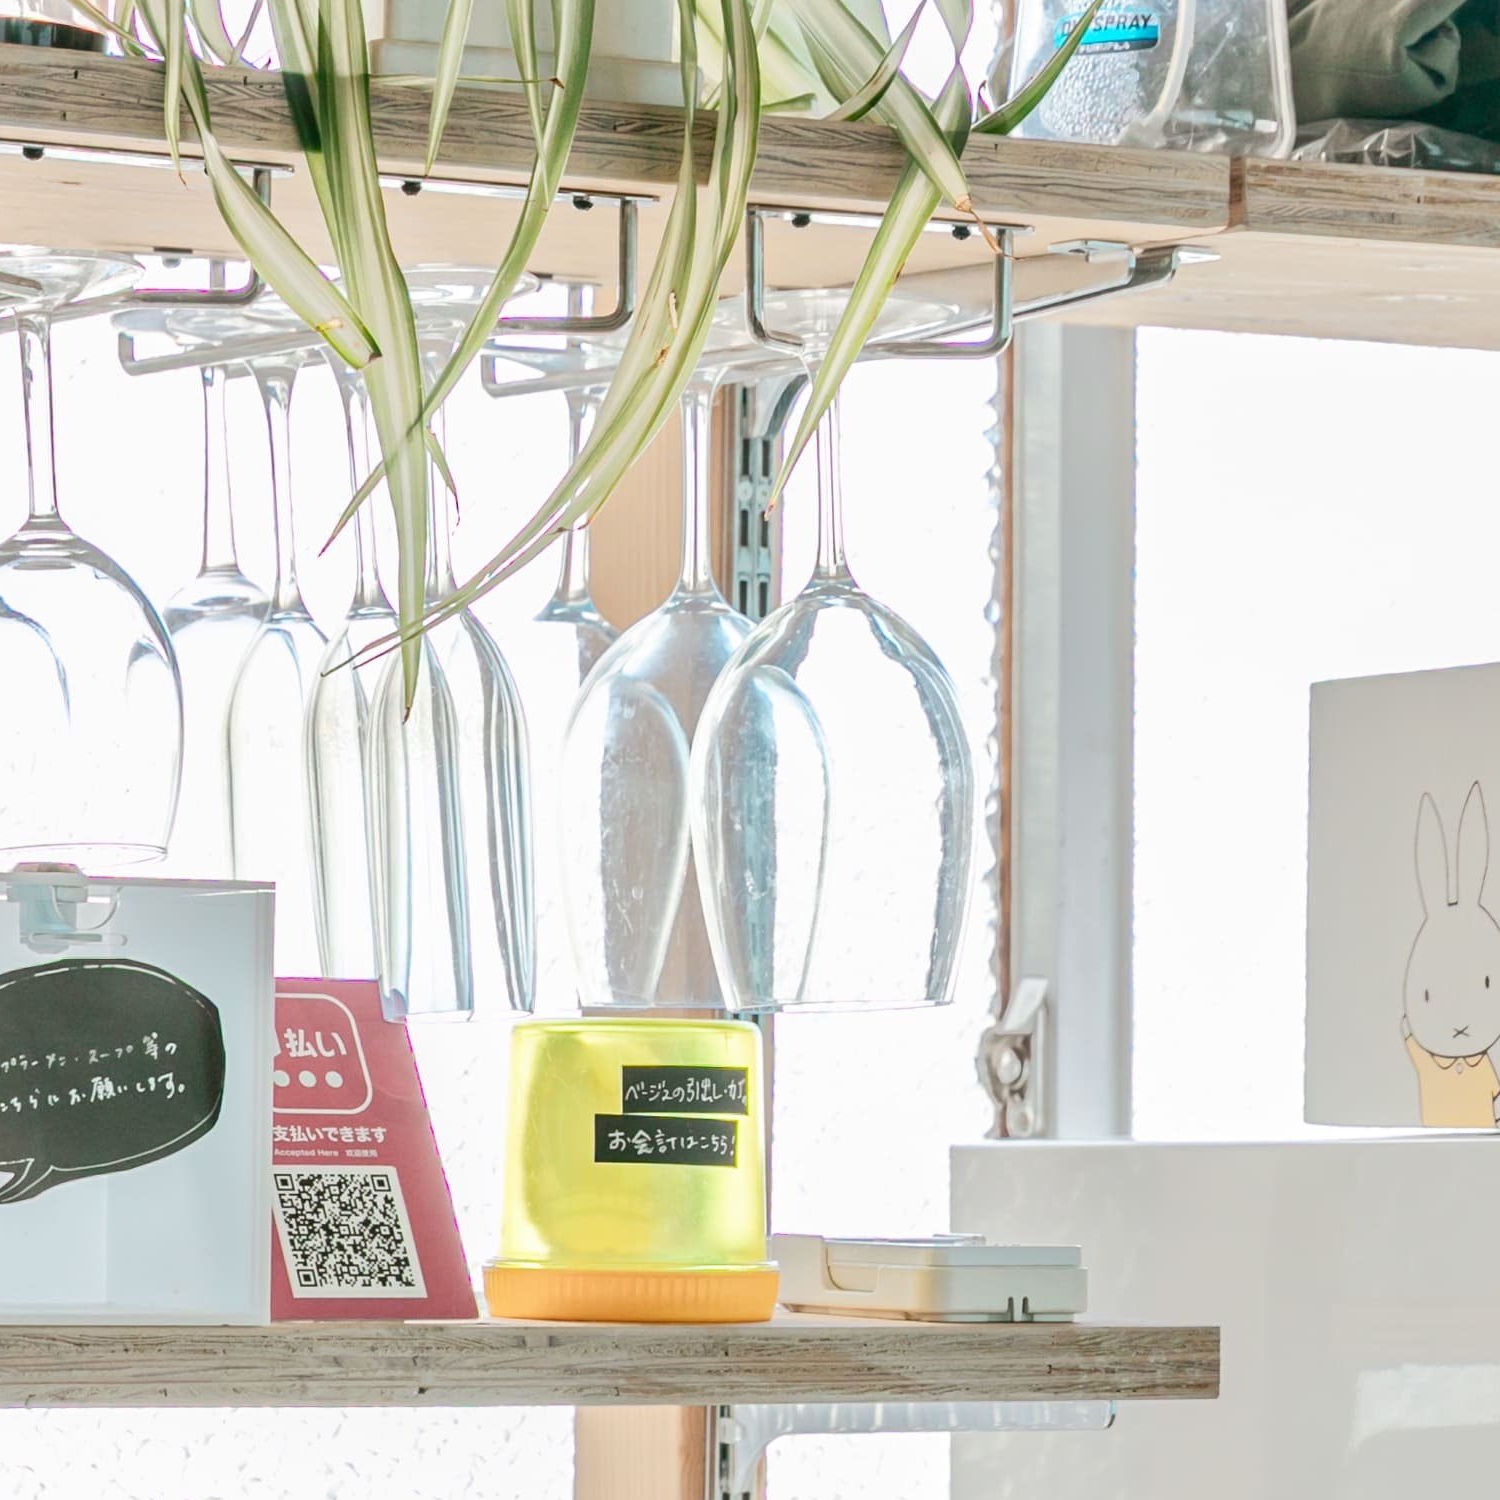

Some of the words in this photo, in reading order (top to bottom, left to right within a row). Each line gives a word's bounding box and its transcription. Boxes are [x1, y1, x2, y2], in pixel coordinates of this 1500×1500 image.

[1093, 14, 1153, 31] SPRAY
[274, 1028, 347, 1057] 払い
[273, 1148, 316, 1158] Accepted
[317, 1148, 340, 1158] Here
